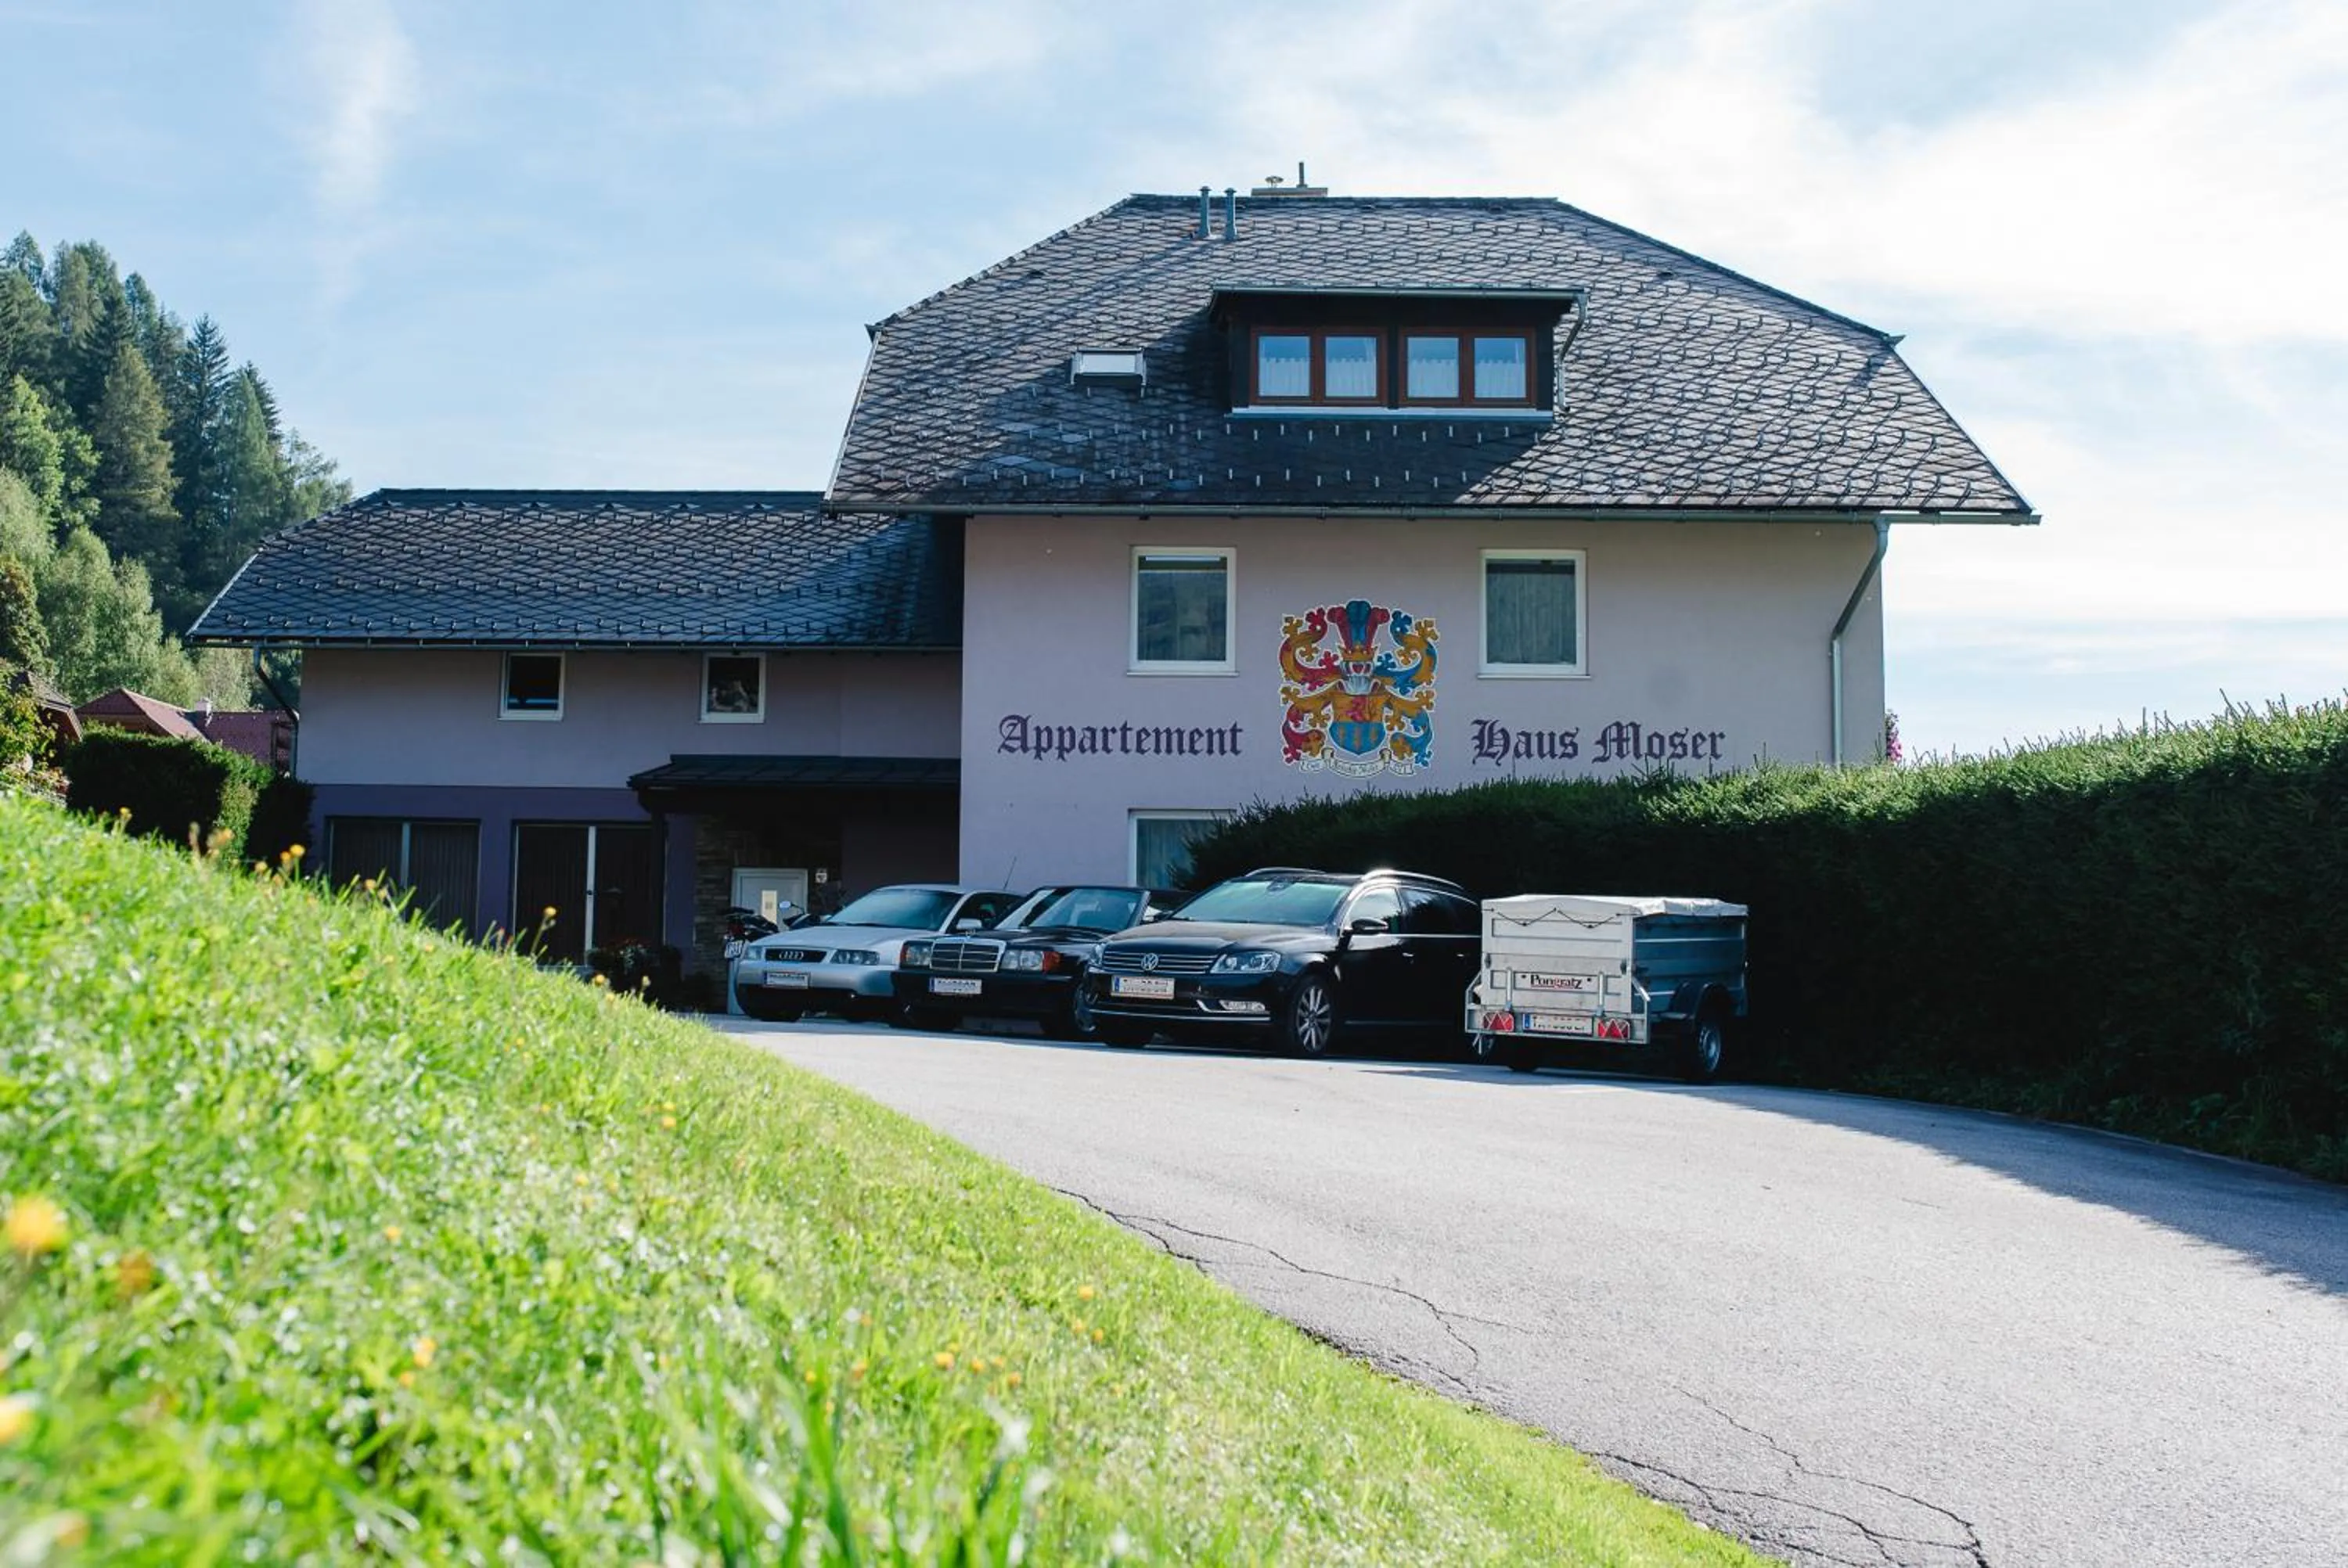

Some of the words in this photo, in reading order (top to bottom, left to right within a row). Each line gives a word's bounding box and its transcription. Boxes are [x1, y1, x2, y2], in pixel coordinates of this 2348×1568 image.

[997, 714, 1243, 762] Appartement
[1471, 718, 1579, 766] Haus
[1591, 720, 1726, 764] Moser
[1530, 974, 1583, 990] Pongratz
